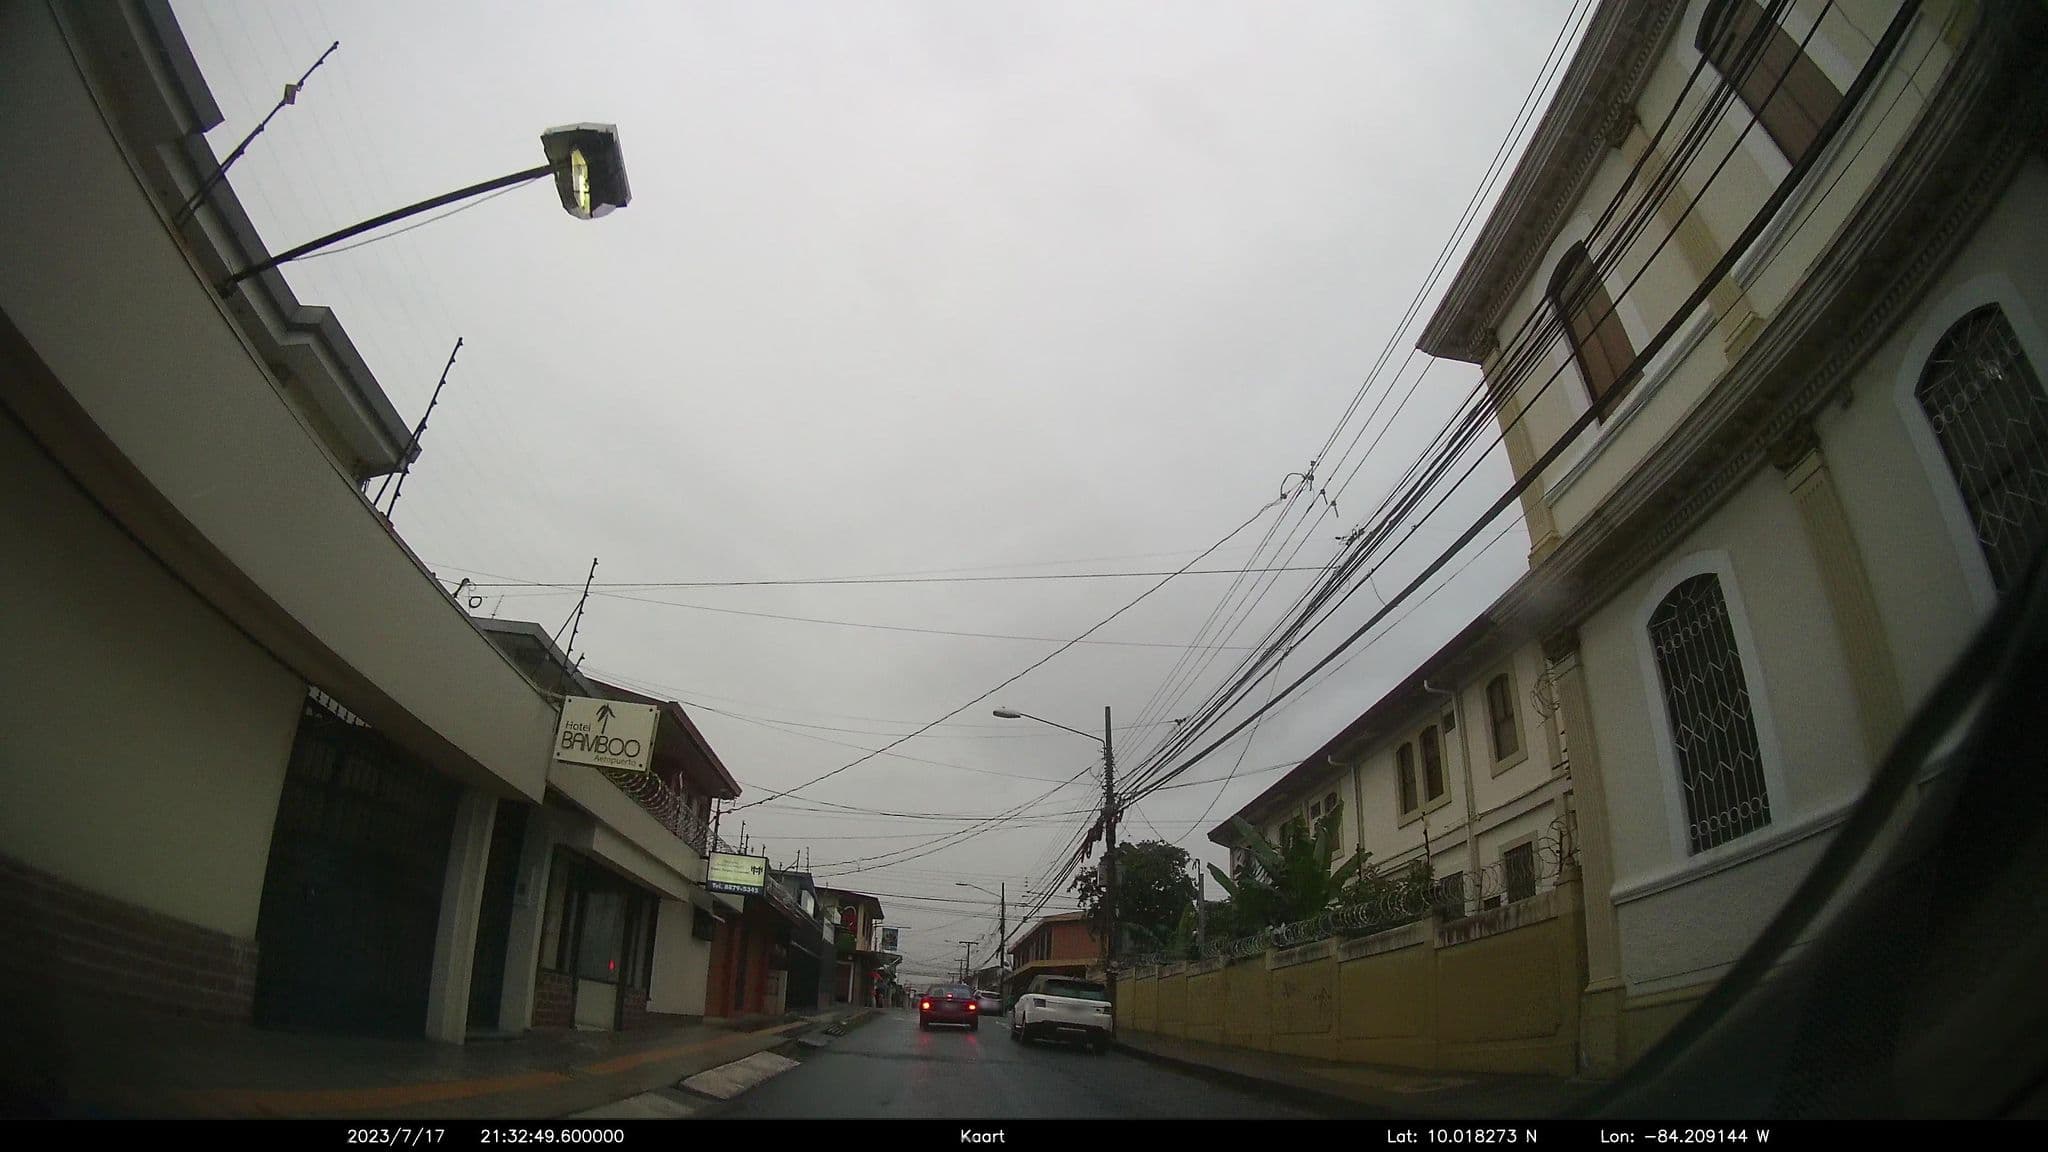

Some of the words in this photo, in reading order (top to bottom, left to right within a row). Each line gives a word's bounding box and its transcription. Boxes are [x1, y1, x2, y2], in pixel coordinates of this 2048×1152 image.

[565, 721, 592, 732] Hotel
[561, 731, 641, 758] BAMBOO
[594, 755, 638, 767] Aeropuerto
